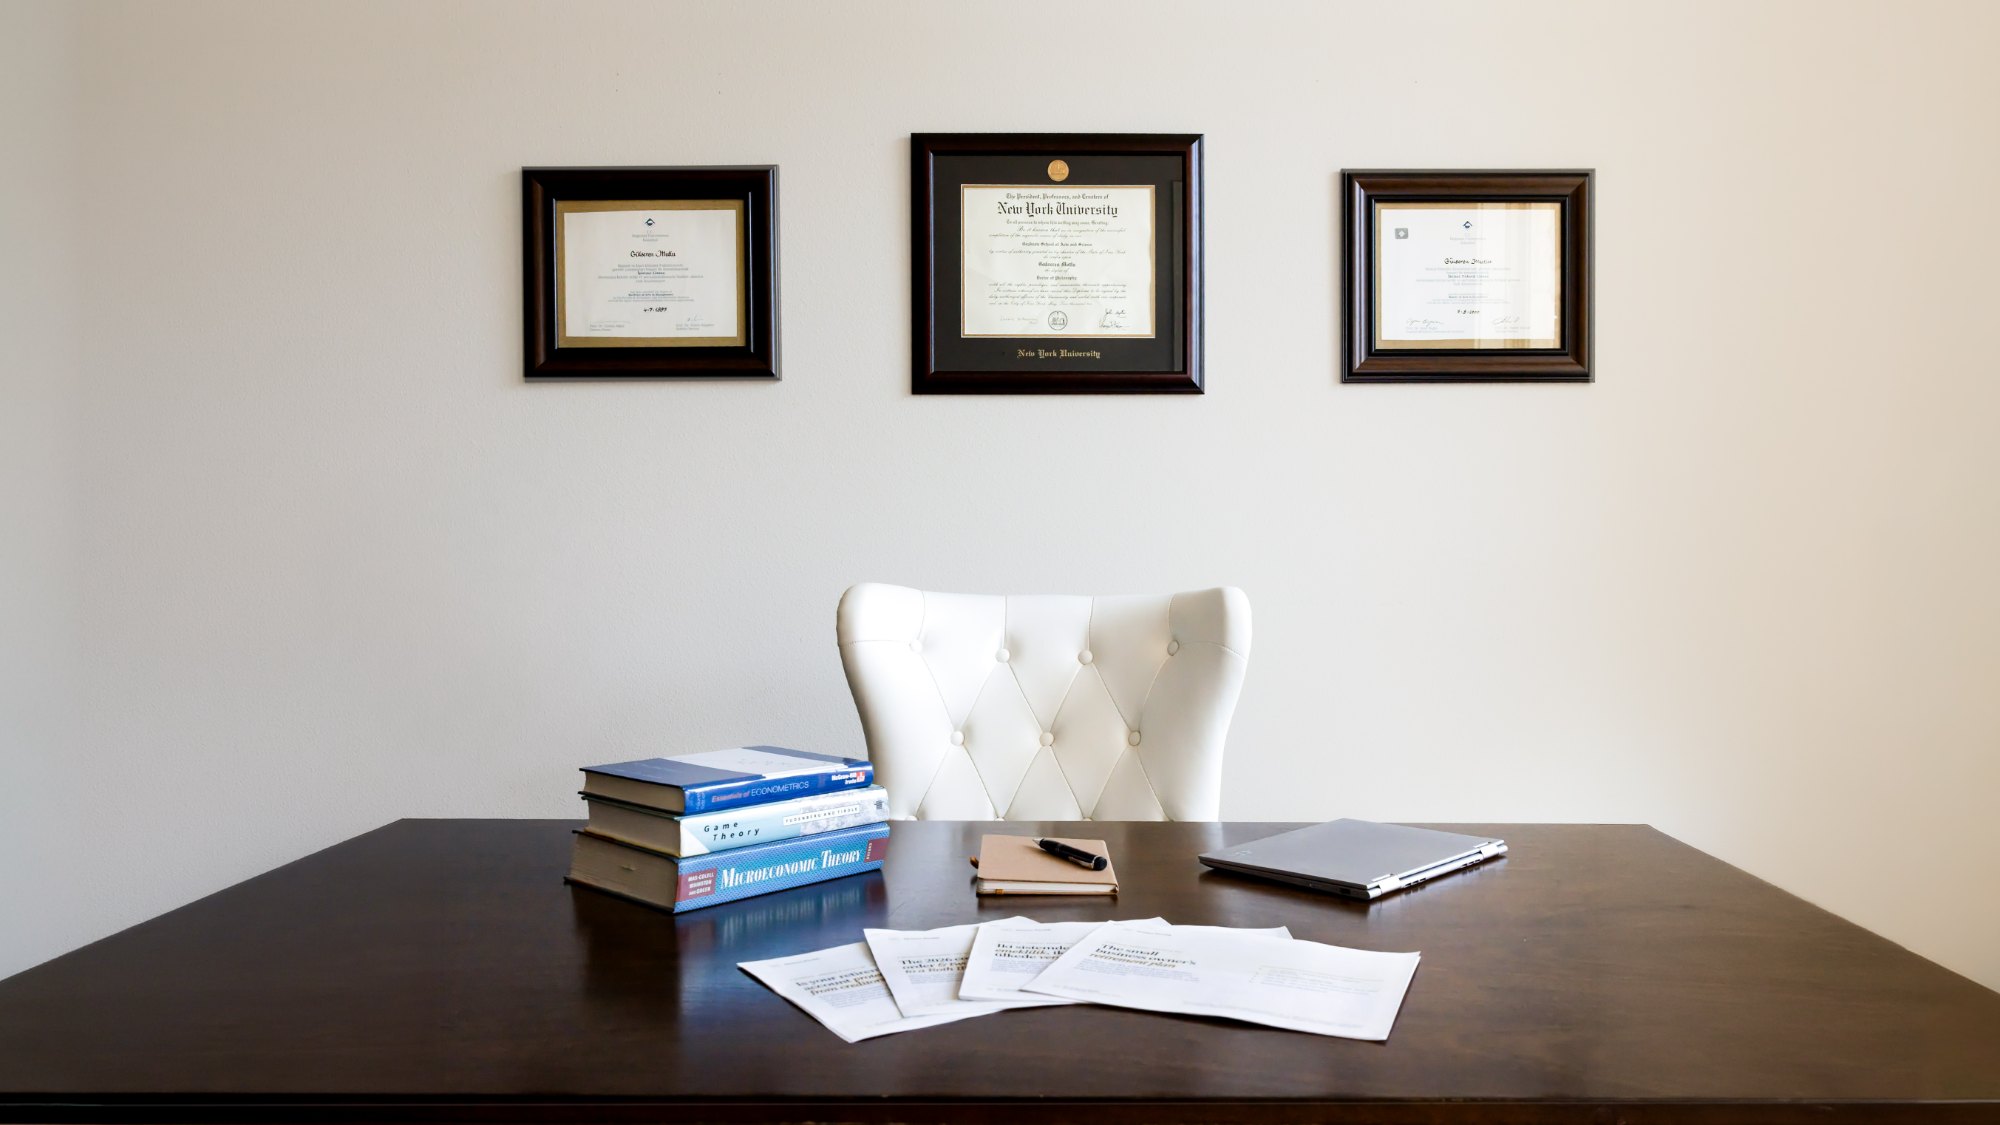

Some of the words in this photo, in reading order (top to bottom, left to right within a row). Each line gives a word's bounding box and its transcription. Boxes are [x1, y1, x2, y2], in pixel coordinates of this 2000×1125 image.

[997, 201, 1023, 215] New
[1026, 201, 1054, 218] York
[1056, 201, 1118, 218] University
[1017, 349, 1035, 358] New
[1037, 348, 1057, 359] York
[1059, 348, 1101, 359] University
[711, 791, 743, 803] Essentials
[743, 790, 751, 798] of
[751, 781, 810, 797] ECONOMETRICS
[785, 813, 821, 823] FUDENBERG
[823, 810, 836, 818] AND
[837, 806, 858, 815] TIROLE
[703, 821, 739, 833] Game
[713, 828, 760, 841] Theory
[720, 857, 820, 889] MICROECONOMIC
[820, 849, 863, 869] THEORY
[1095, 948, 1146, 960] business
[1125, 948, 1160, 956] small
[1089, 953, 1148, 965] retirement
[809, 976, 836, 985] your
[810, 986, 838, 996] from
